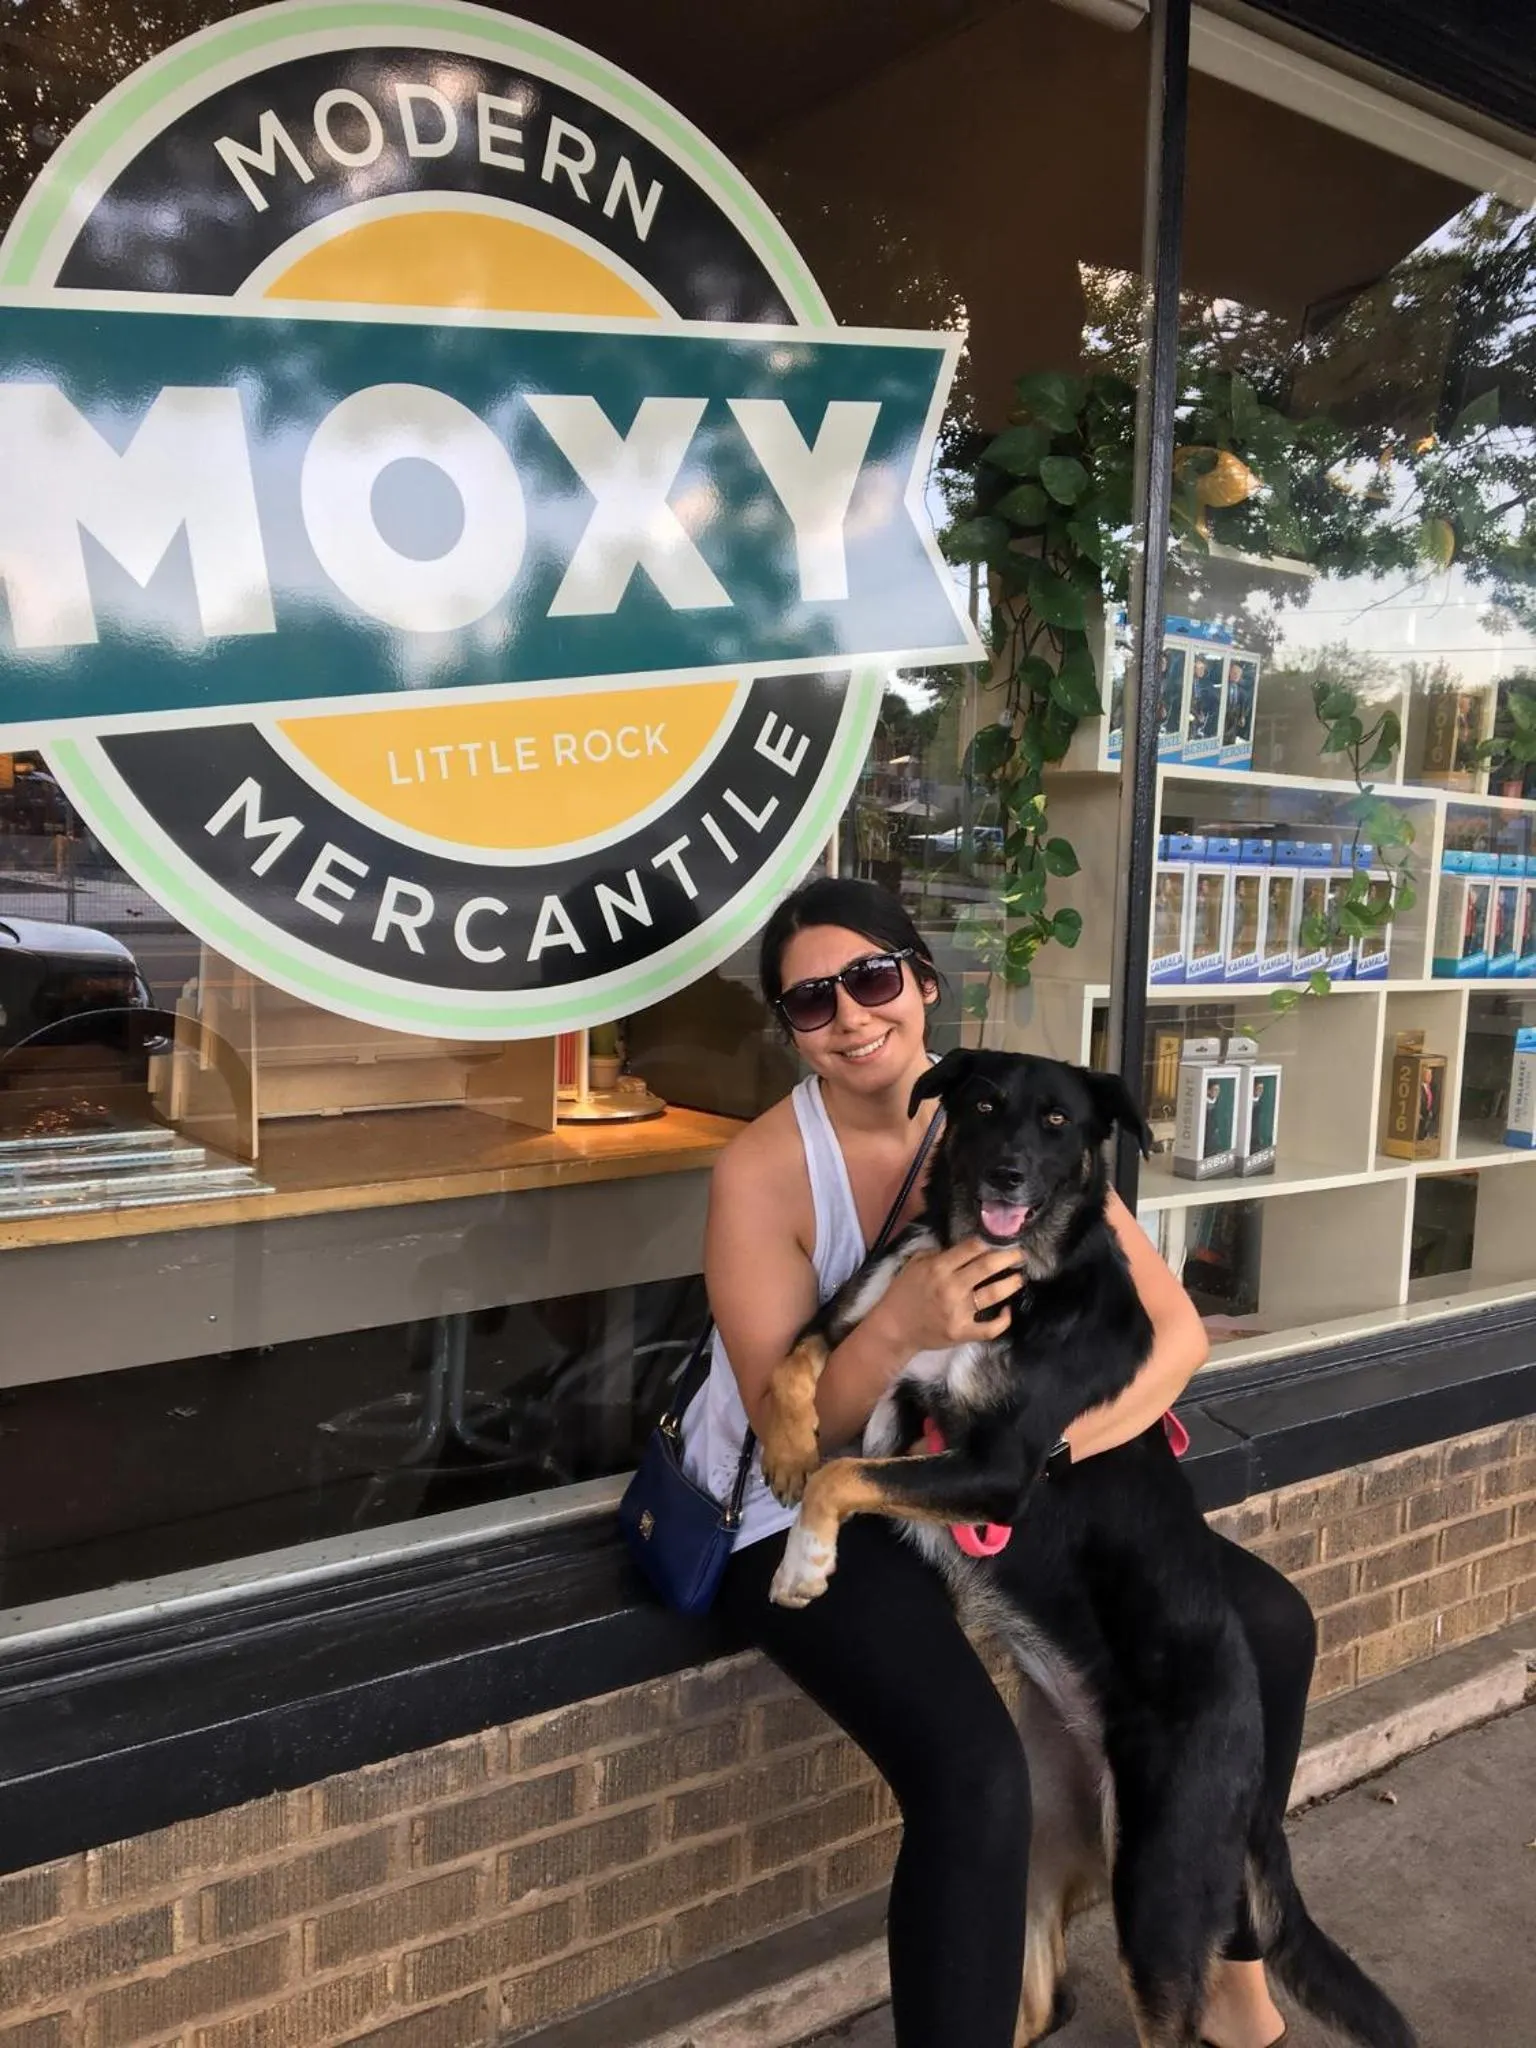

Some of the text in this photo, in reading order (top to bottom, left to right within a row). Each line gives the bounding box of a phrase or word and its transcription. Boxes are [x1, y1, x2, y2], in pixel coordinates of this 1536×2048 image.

[214, 83, 664, 243] MODERN
[0, 382, 883, 648] MOXY
[386, 722, 670, 786] LITTLE ROCK
[203, 710, 812, 965] MERCANTILE
[1188, 953, 1223, 973] KAMALA
[1227, 952, 1259, 973] KAMALA
[1261, 952, 1291, 973] KAMALA
[1295, 952, 1323, 973] KAMALA
[1358, 952, 1388, 972] KAMALA
[1182, 1078, 1194, 1140] DISSENT
[1395, 1066, 1412, 1132] 2016
[1206, 1154, 1227, 1169] RBG
[1252, 1151, 1269, 1166] RBG
